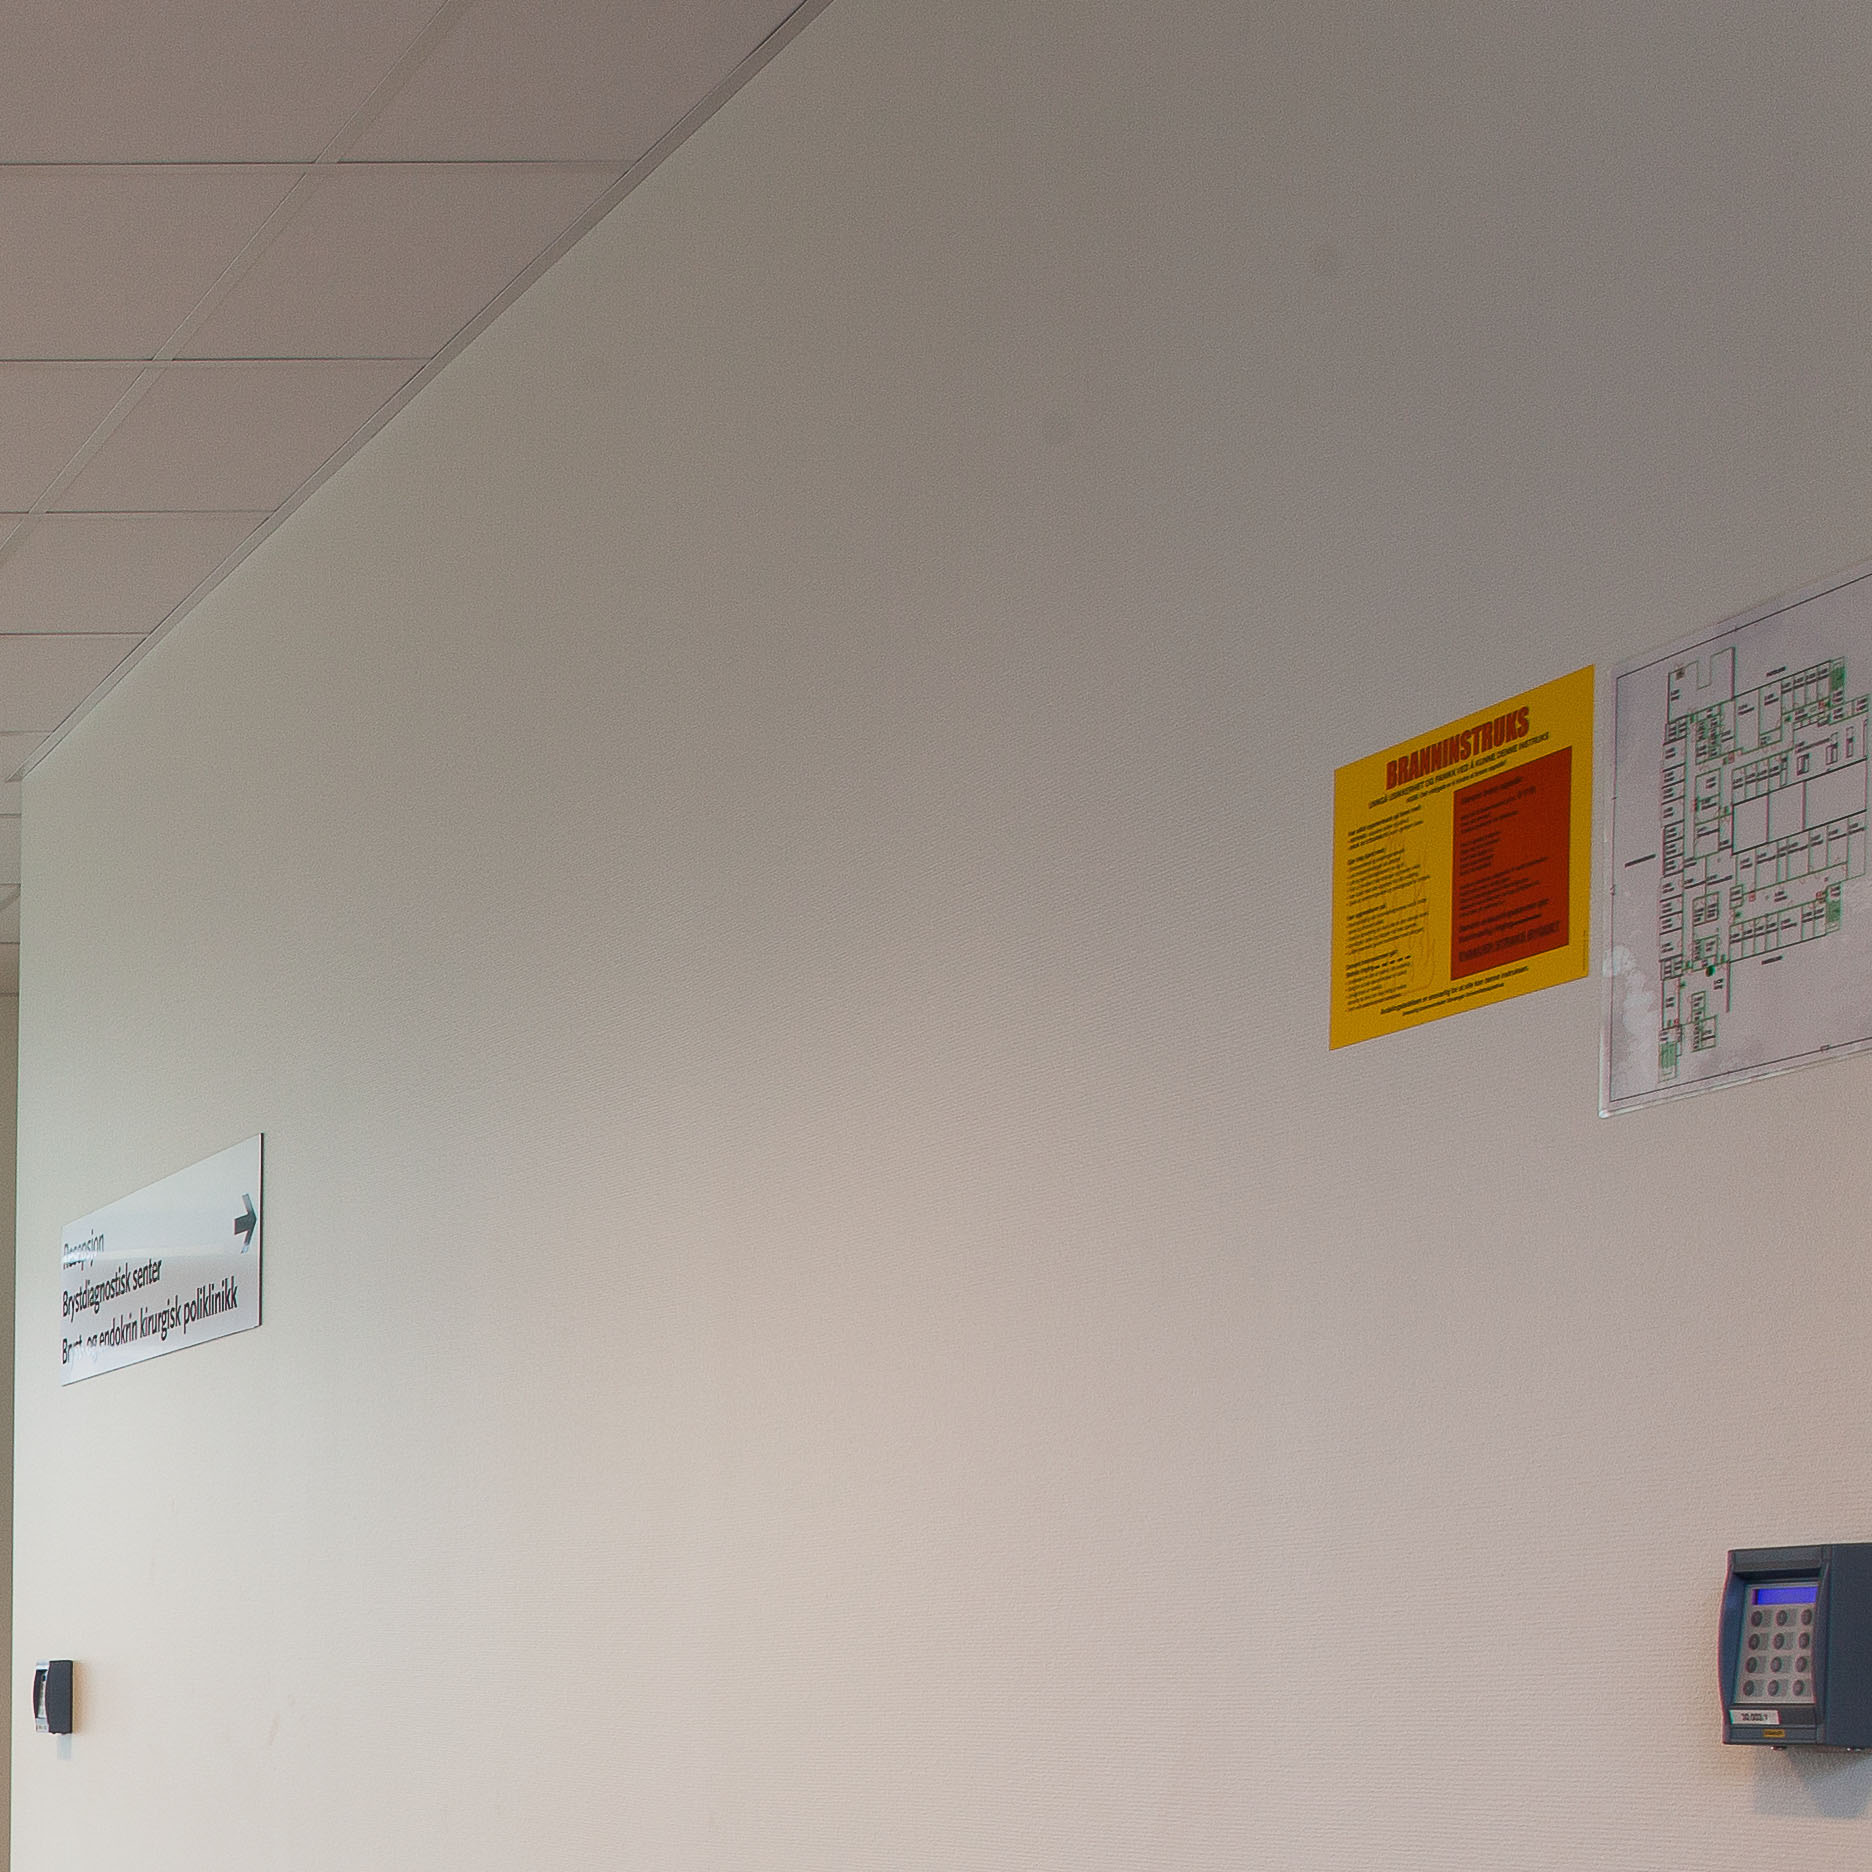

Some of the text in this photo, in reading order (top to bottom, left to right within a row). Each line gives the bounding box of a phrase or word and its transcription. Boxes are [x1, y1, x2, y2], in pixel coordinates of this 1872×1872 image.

[1386, 706, 1530, 790] BRANNINSTRUKS
[62, 1258, 162, 1322] Brystdiagnostisk senter
[99, 1313, 138, 1349] endokrin
[139, 1295, 182, 1341] kirurgisk
[183, 1275, 239, 1333] poliklinikk
